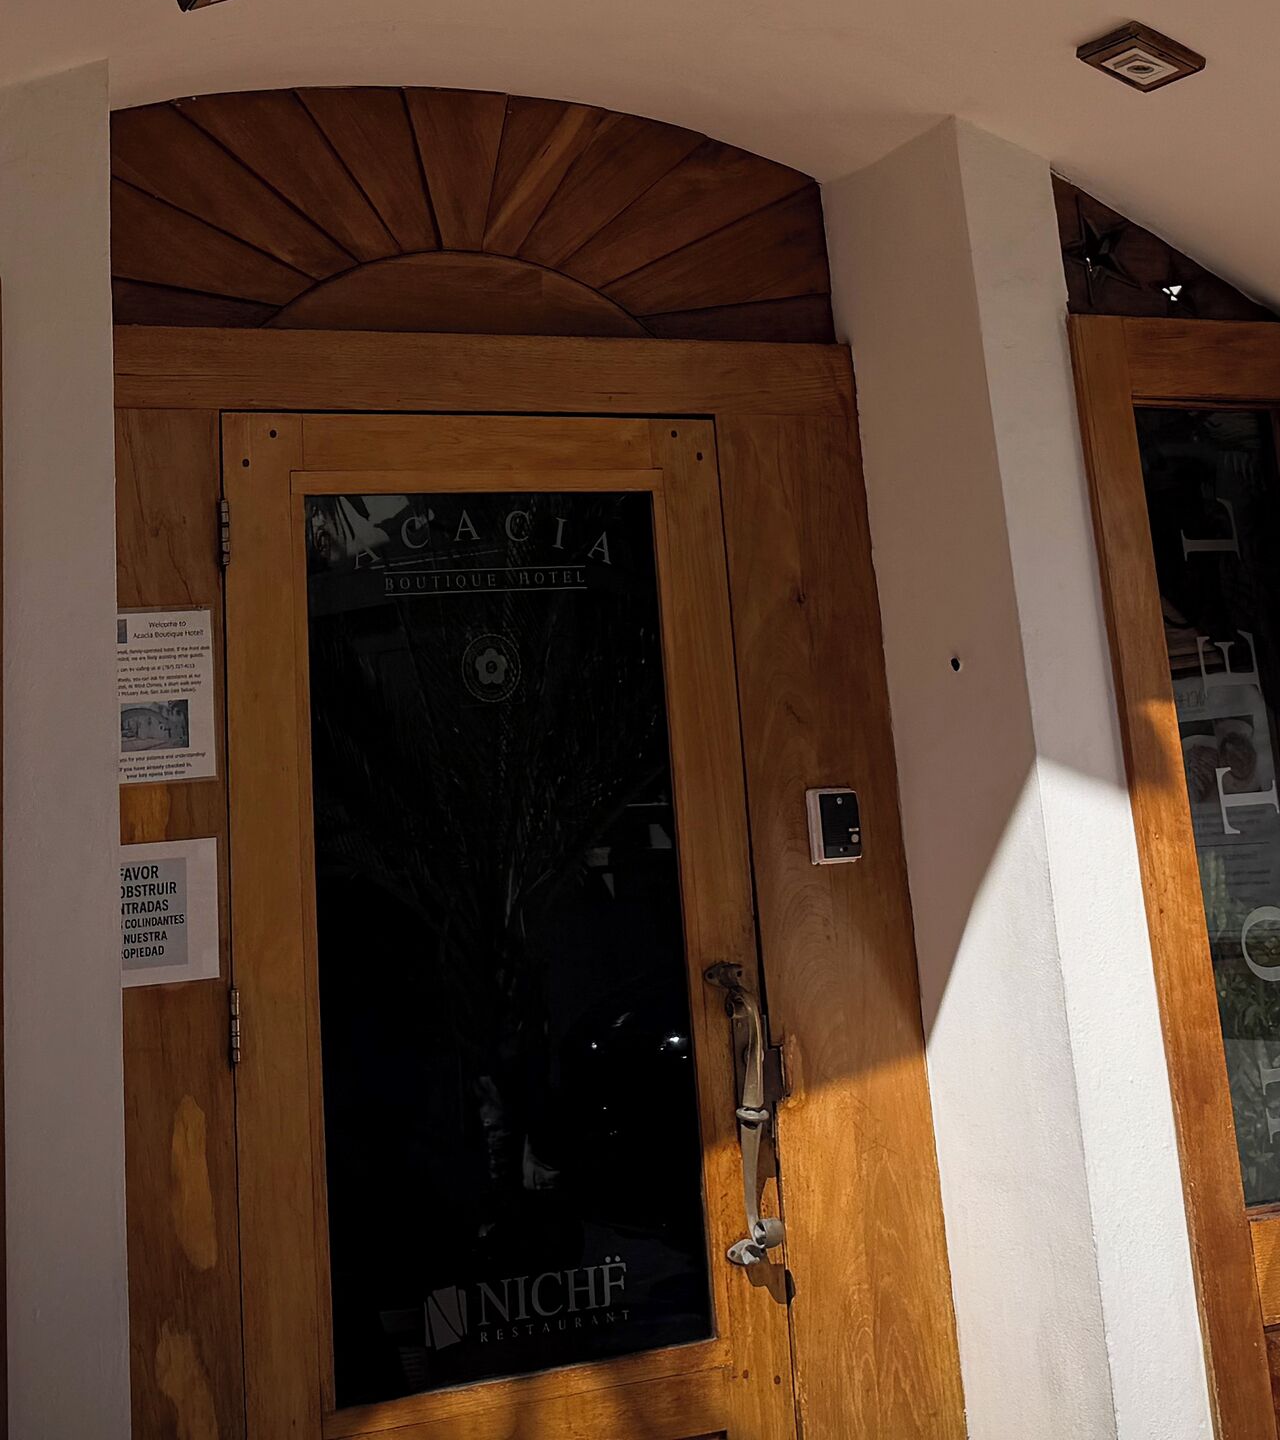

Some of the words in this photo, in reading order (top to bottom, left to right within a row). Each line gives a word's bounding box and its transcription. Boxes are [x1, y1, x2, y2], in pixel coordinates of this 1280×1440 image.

[352, 509, 612, 570] ACACIA
[385, 573, 497, 591] BOUTIQUE
[519, 570, 586, 586] HOTEL
[121, 899, 169, 915] NTRADAS
[125, 914, 185, 929] COLINDANTES
[123, 930, 168, 944] NUESTRA
[121, 945, 165, 960] OPIEDAD
[480, 1309, 631, 1344] RESTAURANT
